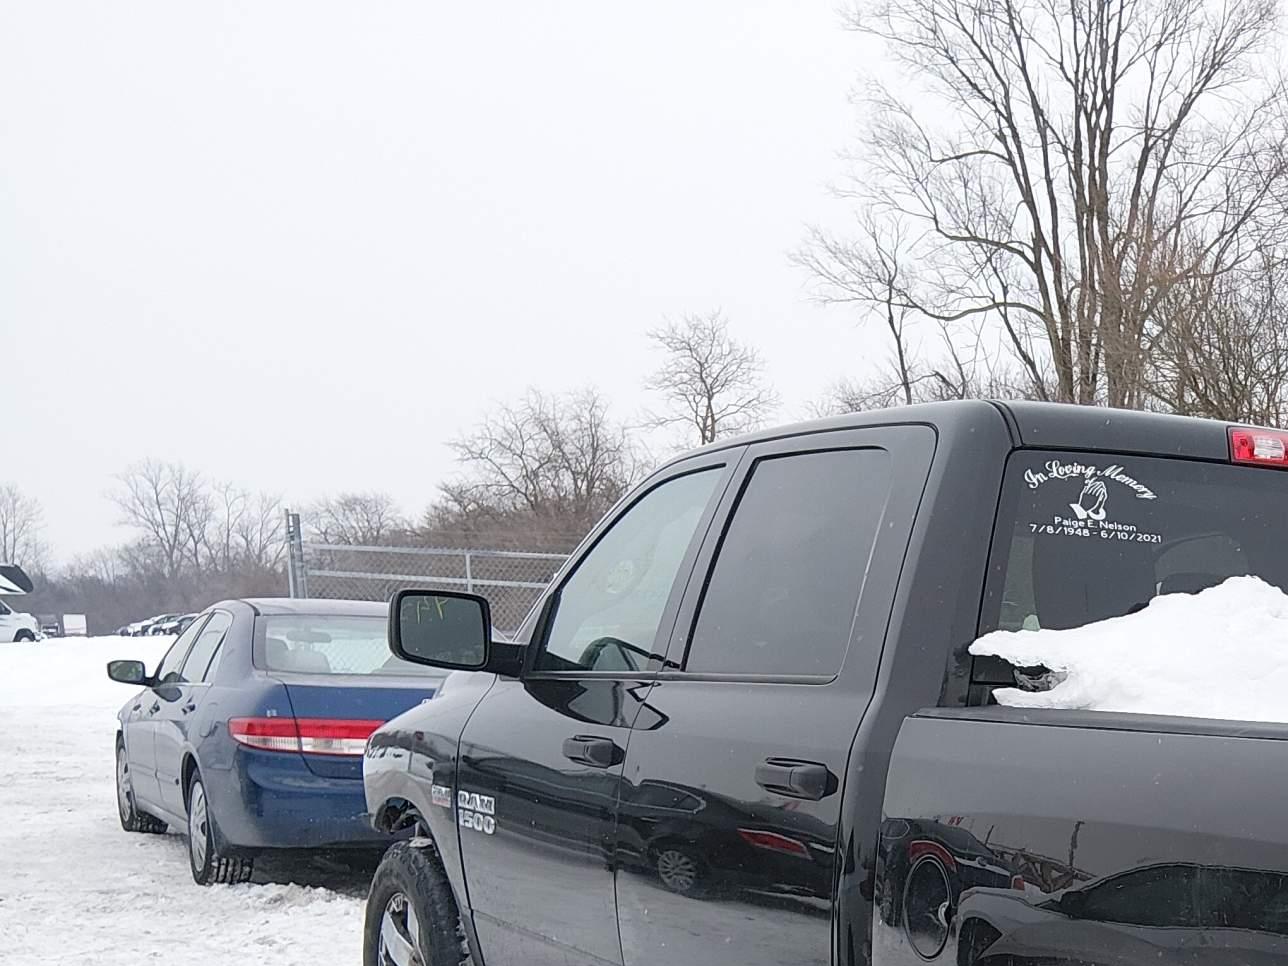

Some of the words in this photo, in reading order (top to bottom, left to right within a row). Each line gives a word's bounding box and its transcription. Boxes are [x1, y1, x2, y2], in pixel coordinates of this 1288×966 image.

[1024, 469, 1048, 489] In
[1045, 460, 1096, 479] Loving
[1097, 464, 1157, 500] Memory
[1029, 524, 1090, 537] 7/8/1948
[1100, 530, 1162, 543] 6/10/2021
[1054, 516, 1085, 529] Paige
[1100, 521, 1137, 532] Nelson
[458, 790, 496, 815] RAM
[458, 809, 496, 835] 1500
